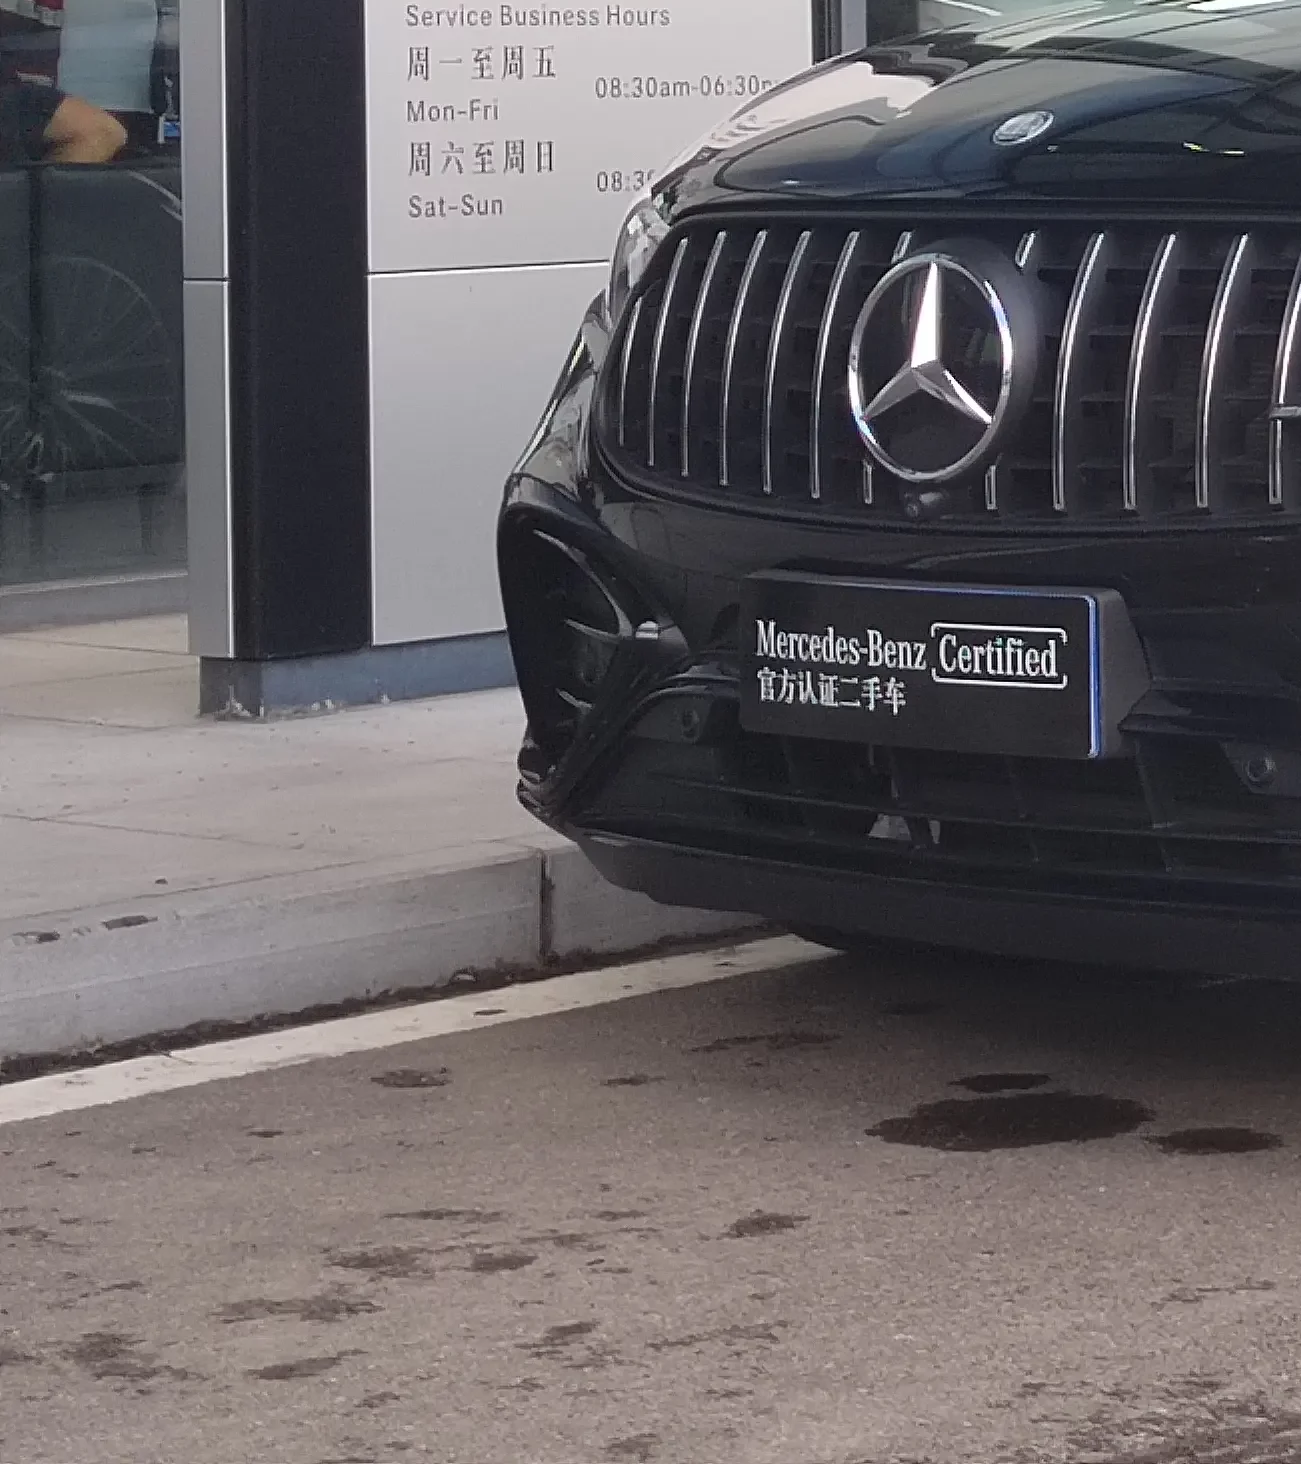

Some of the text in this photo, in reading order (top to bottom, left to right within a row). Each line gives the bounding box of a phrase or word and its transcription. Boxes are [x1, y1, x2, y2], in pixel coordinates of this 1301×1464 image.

[405, 3, 670, 27] Service Business Hours
[407, 44, 557, 82] 周一至周五
[595, 74, 779, 98] 08:30am-06:30
[406, 98, 499, 123] Mon-Fri
[408, 138, 555, 177] 周六至周日
[408, 193, 504, 219] Sat-Sun
[755, 619, 1058, 678] Mercedes-Benz Certified
[756, 666, 907, 716] 官方认证二手车
